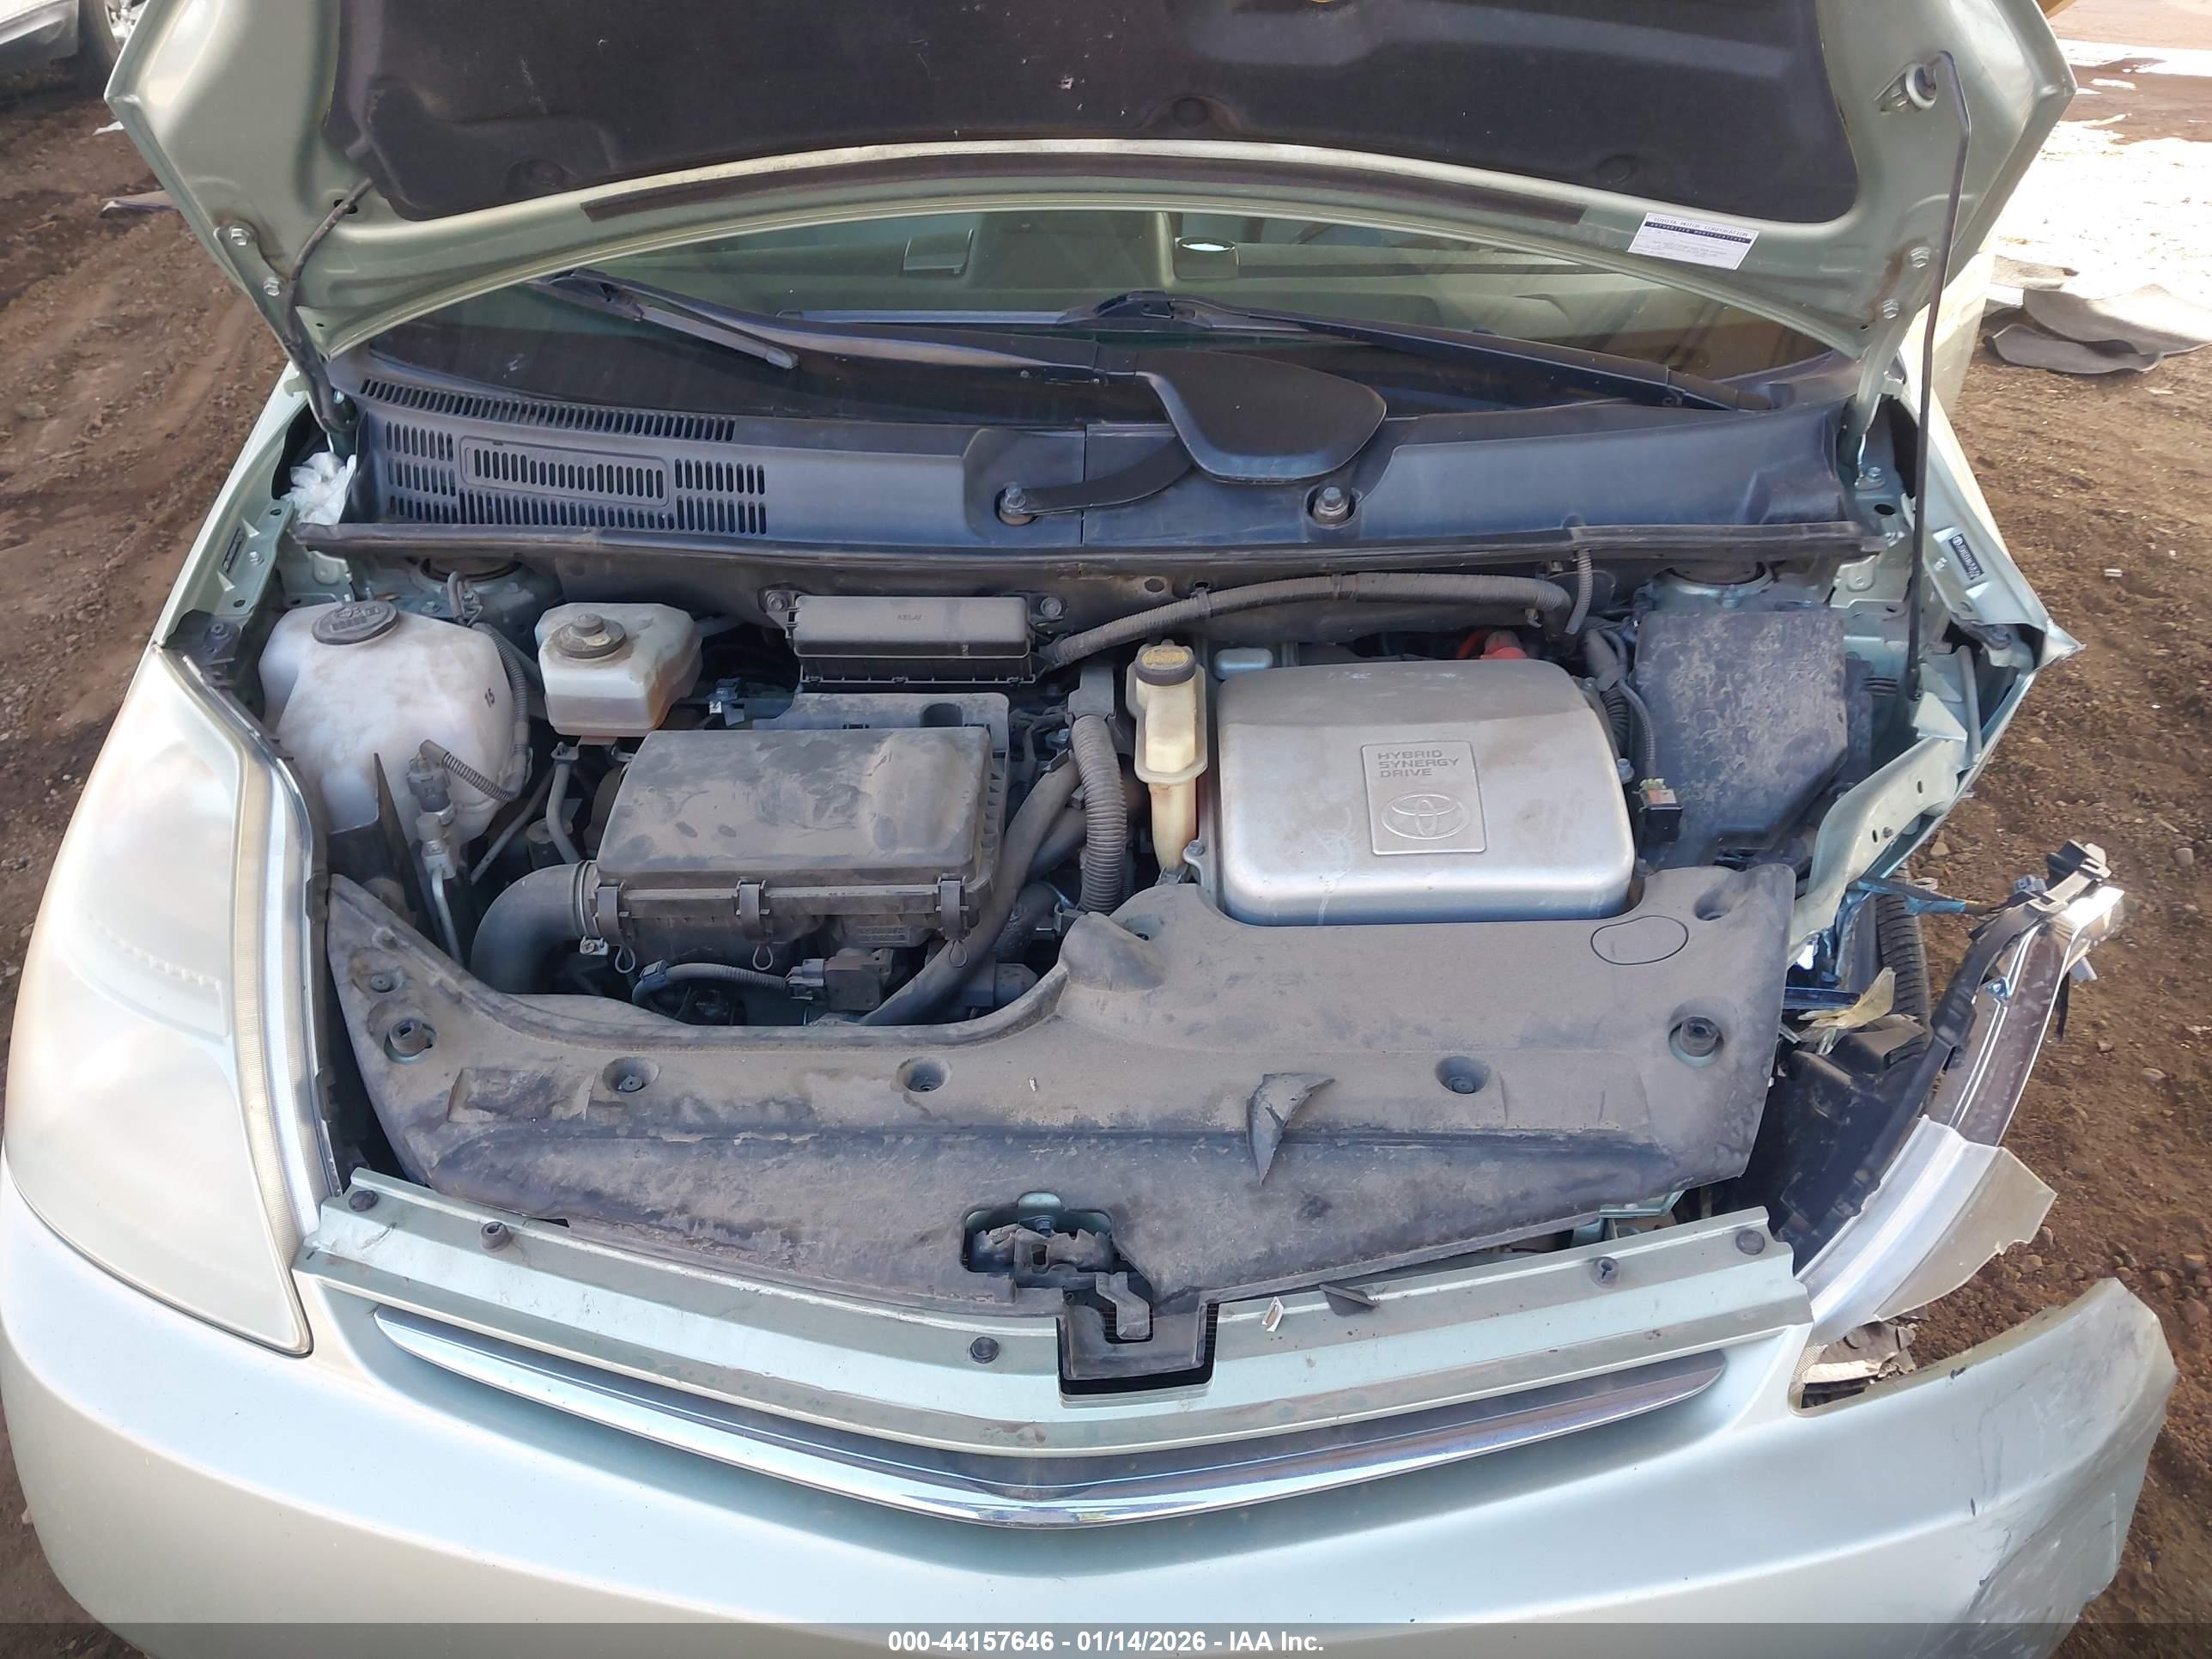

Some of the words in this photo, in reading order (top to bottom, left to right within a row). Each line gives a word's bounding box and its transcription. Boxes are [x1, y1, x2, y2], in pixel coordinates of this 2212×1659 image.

[484, 687, 495, 708] 15
[1377, 750, 1443, 760] HYBRID
[1378, 757, 1459, 769] SYNERGY
[1380, 769, 1432, 778] DRIVE
